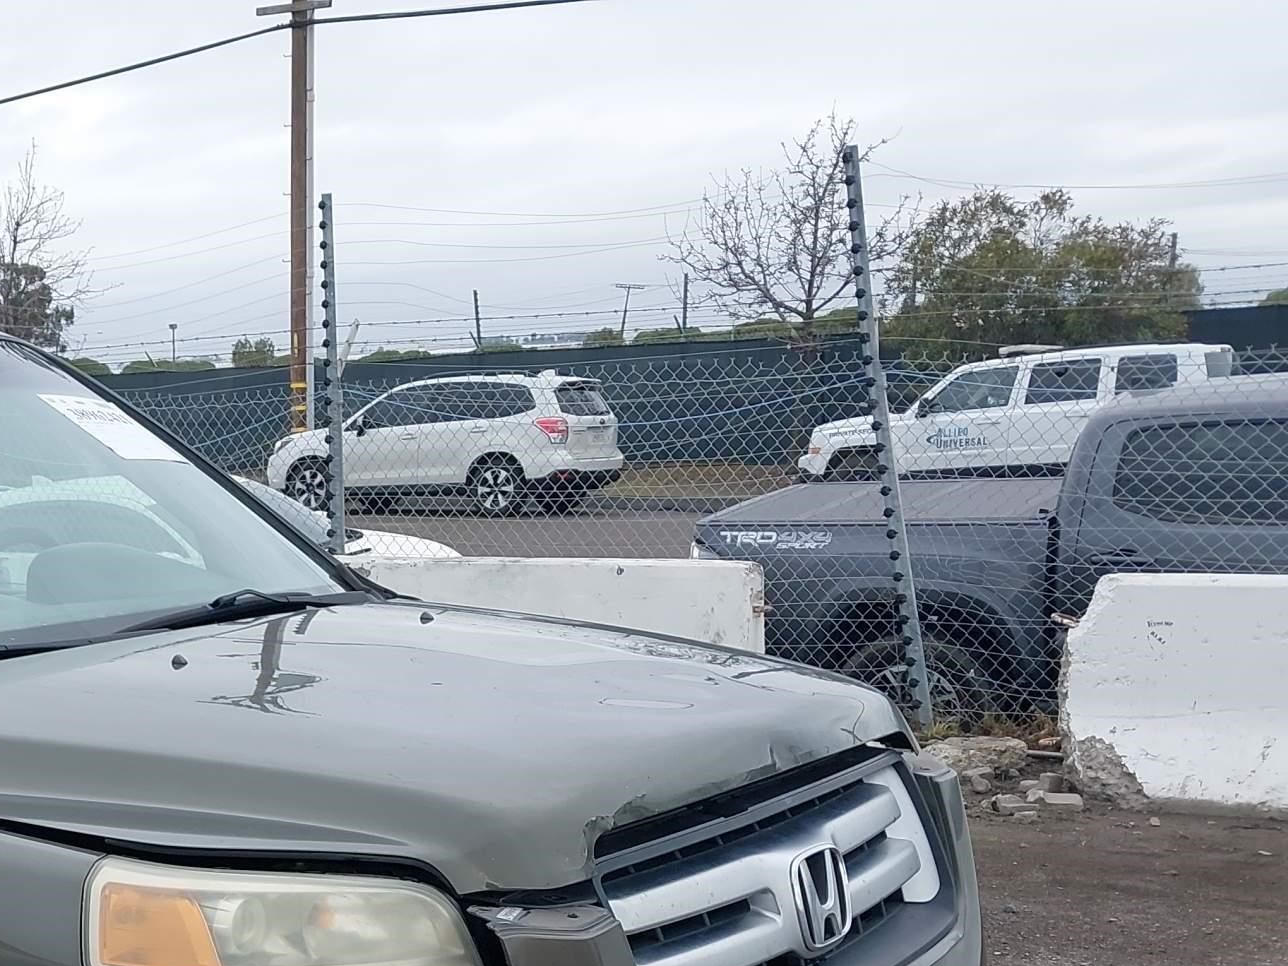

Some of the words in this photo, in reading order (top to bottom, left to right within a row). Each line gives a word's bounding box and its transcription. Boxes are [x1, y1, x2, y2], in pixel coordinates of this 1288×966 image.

[935, 436, 989, 449] UNIVERSAL
[719, 530, 778, 547] TRD
[775, 541, 829, 549] SPORT
